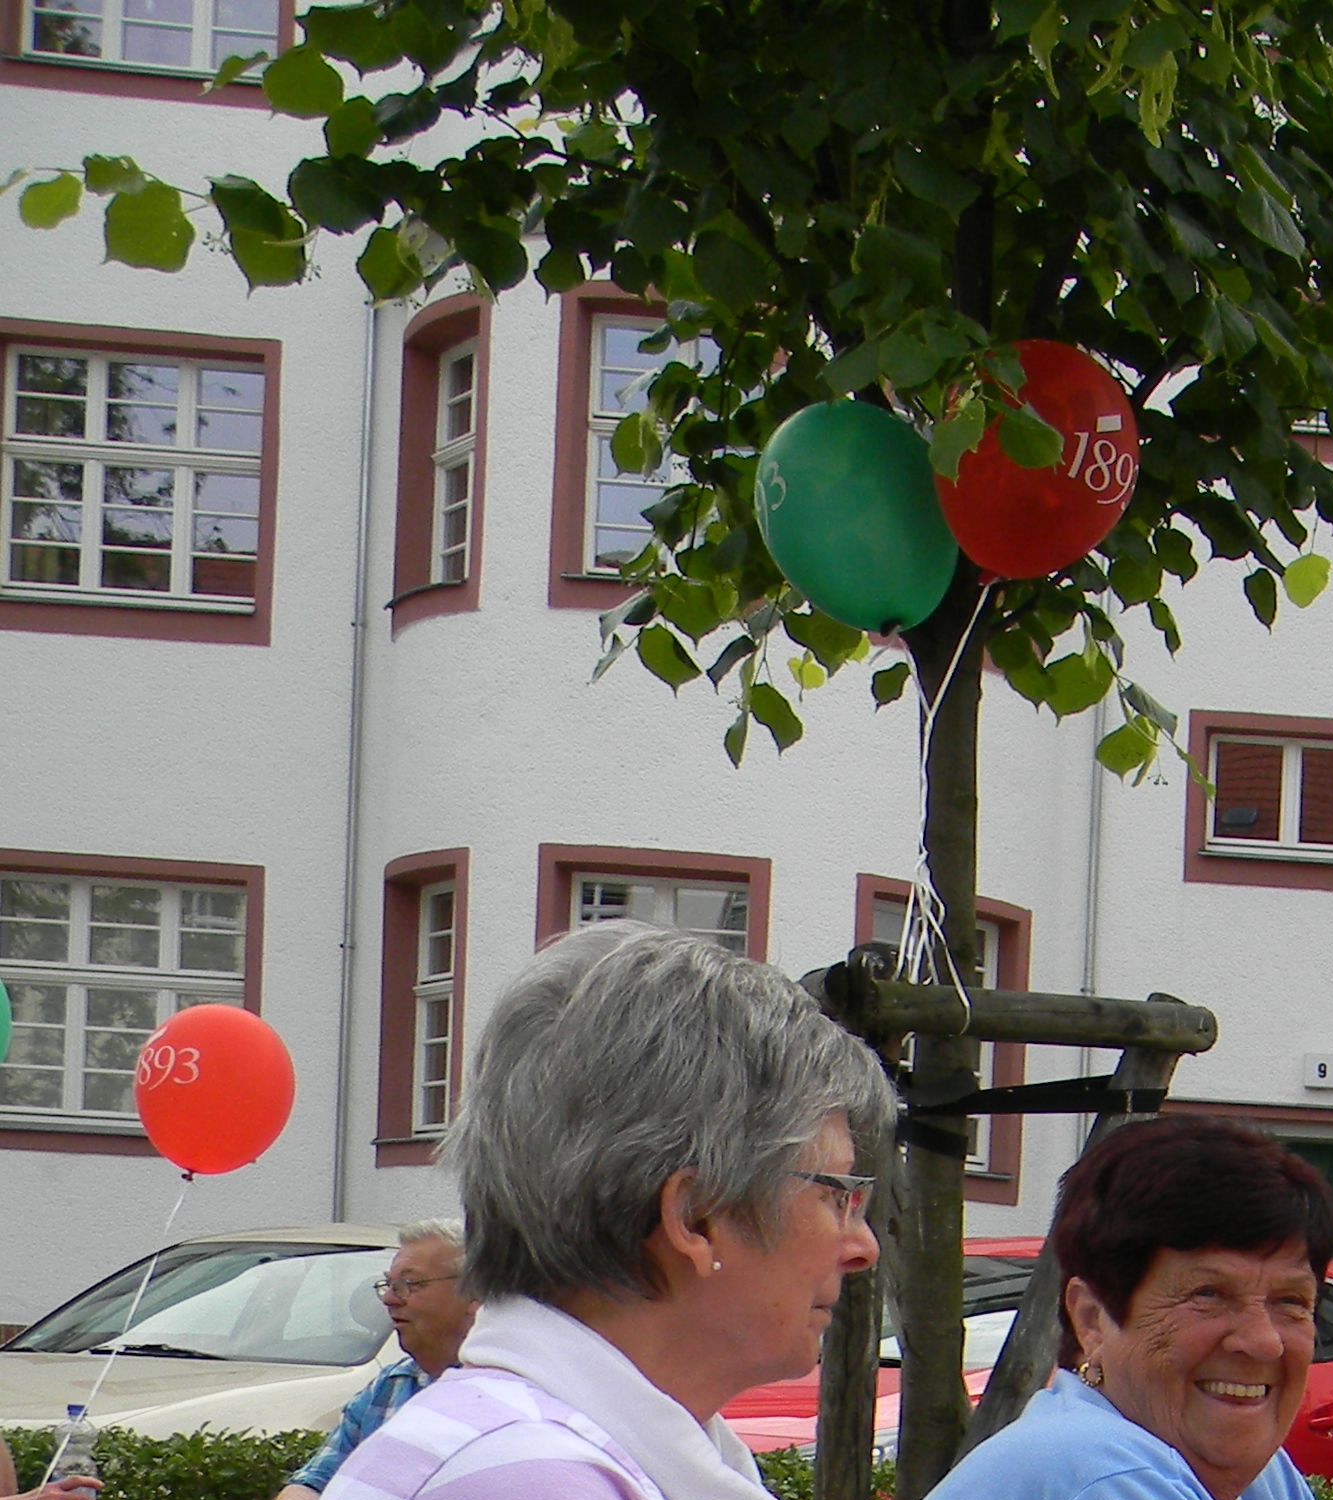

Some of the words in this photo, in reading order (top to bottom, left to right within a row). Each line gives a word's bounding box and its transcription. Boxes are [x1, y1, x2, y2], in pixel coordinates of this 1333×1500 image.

[1067, 432, 1139, 511] 189
[138, 1046, 200, 1091] 893
[1317, 1062, 1327, 1079] 9
